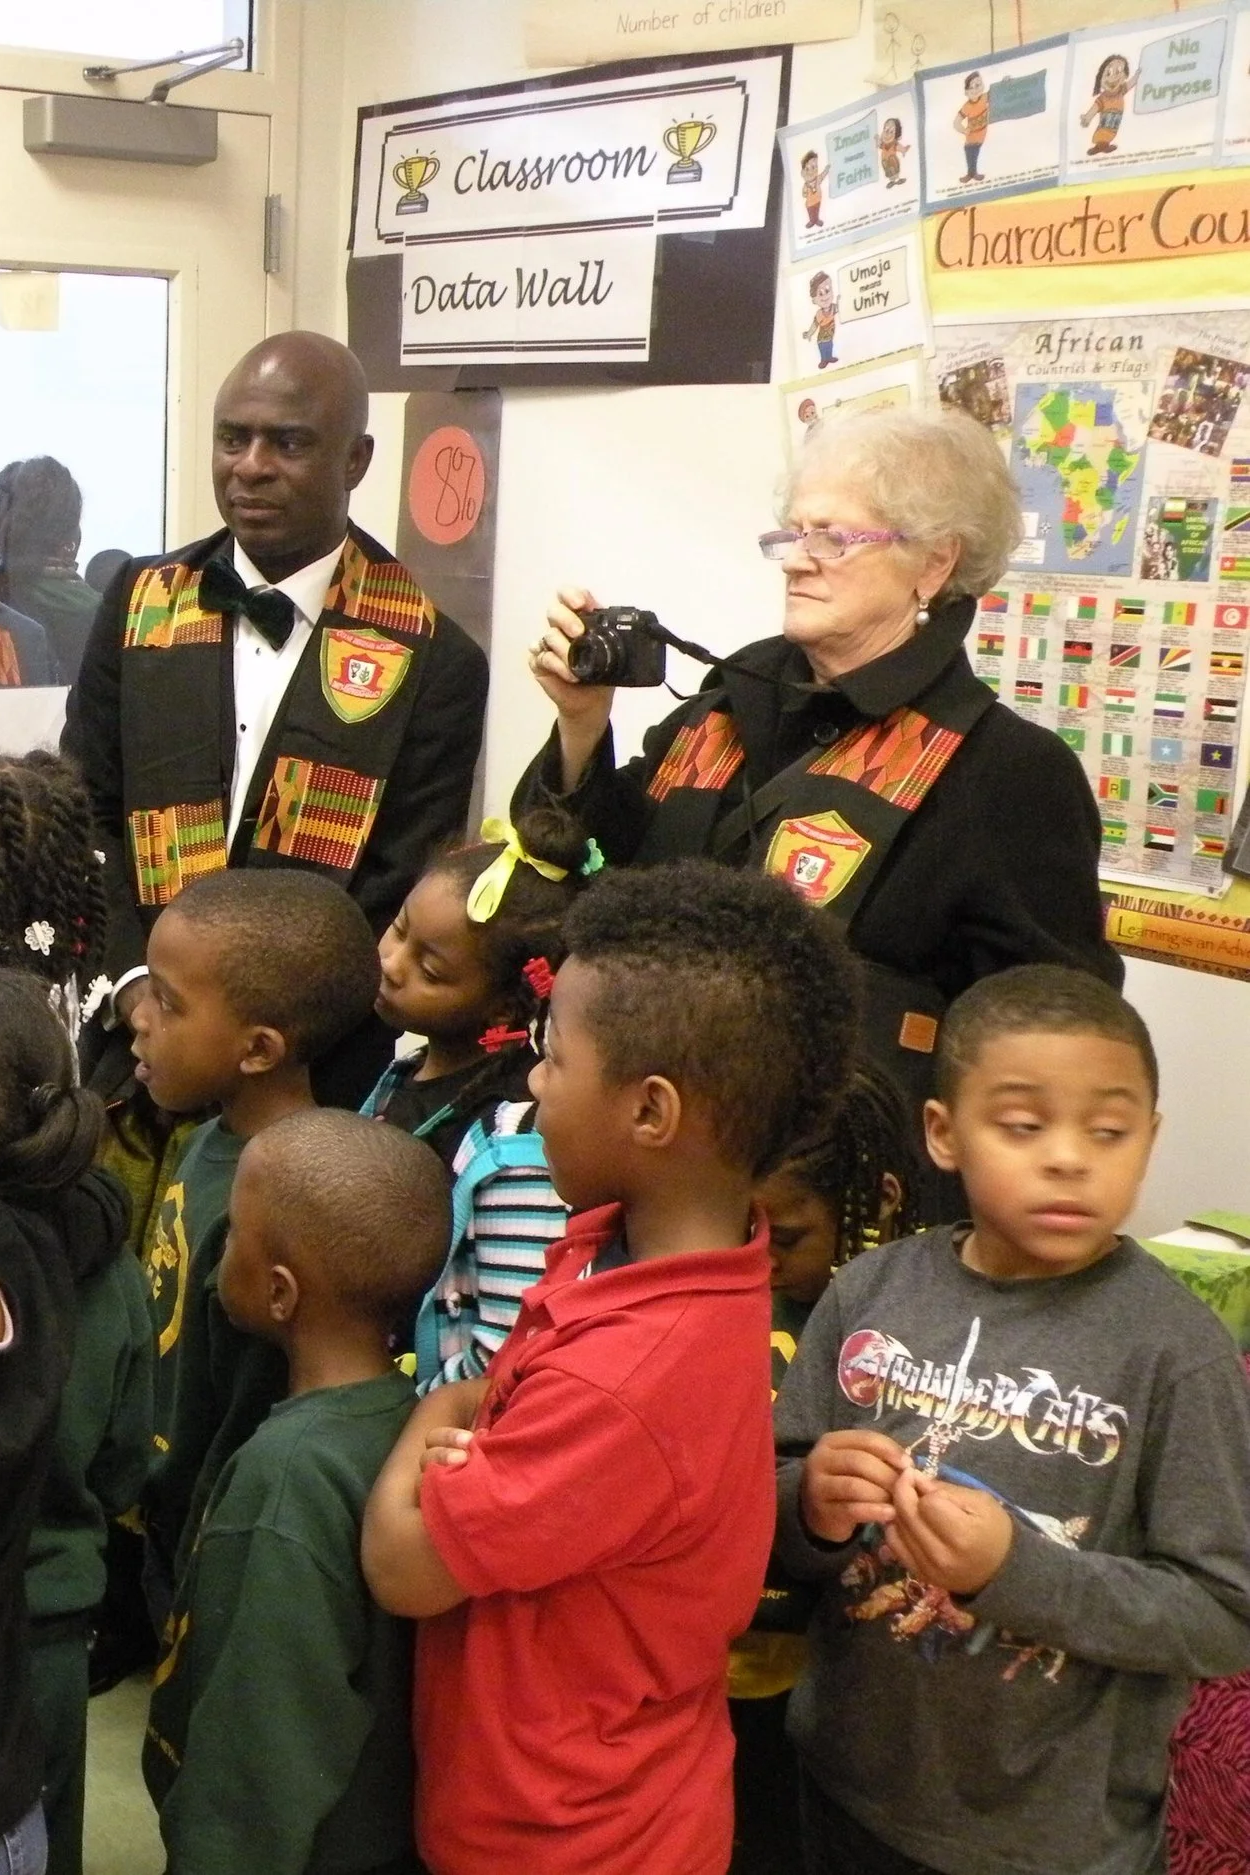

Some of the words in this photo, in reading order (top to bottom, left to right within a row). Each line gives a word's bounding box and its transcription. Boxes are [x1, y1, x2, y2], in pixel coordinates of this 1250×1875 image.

[616, 10, 680, 35] Number
[693, 2, 715, 26] of
[718, 0, 786, 23] children
[1168, 38, 1201, 59] Nia
[1141, 77, 1212, 102] Purpose
[833, 125, 871, 152] Imani
[453, 145, 658, 196] Classroom
[837, 164, 872, 189] Faith
[935, 195, 1144, 270] Character
[850, 259, 891, 283] Umoja
[410, 271, 508, 317] Data
[515, 259, 615, 309] Wall
[853, 291, 889, 311] Unity
[1035, 327, 1144, 365] African
[1026, 363, 1086, 376] Countries
[1092, 362, 1105, 374] &
[1111, 359, 1149, 378] Flags
[1117, 916, 1180, 949] Learning
[1196, 938, 1215, 950] an
